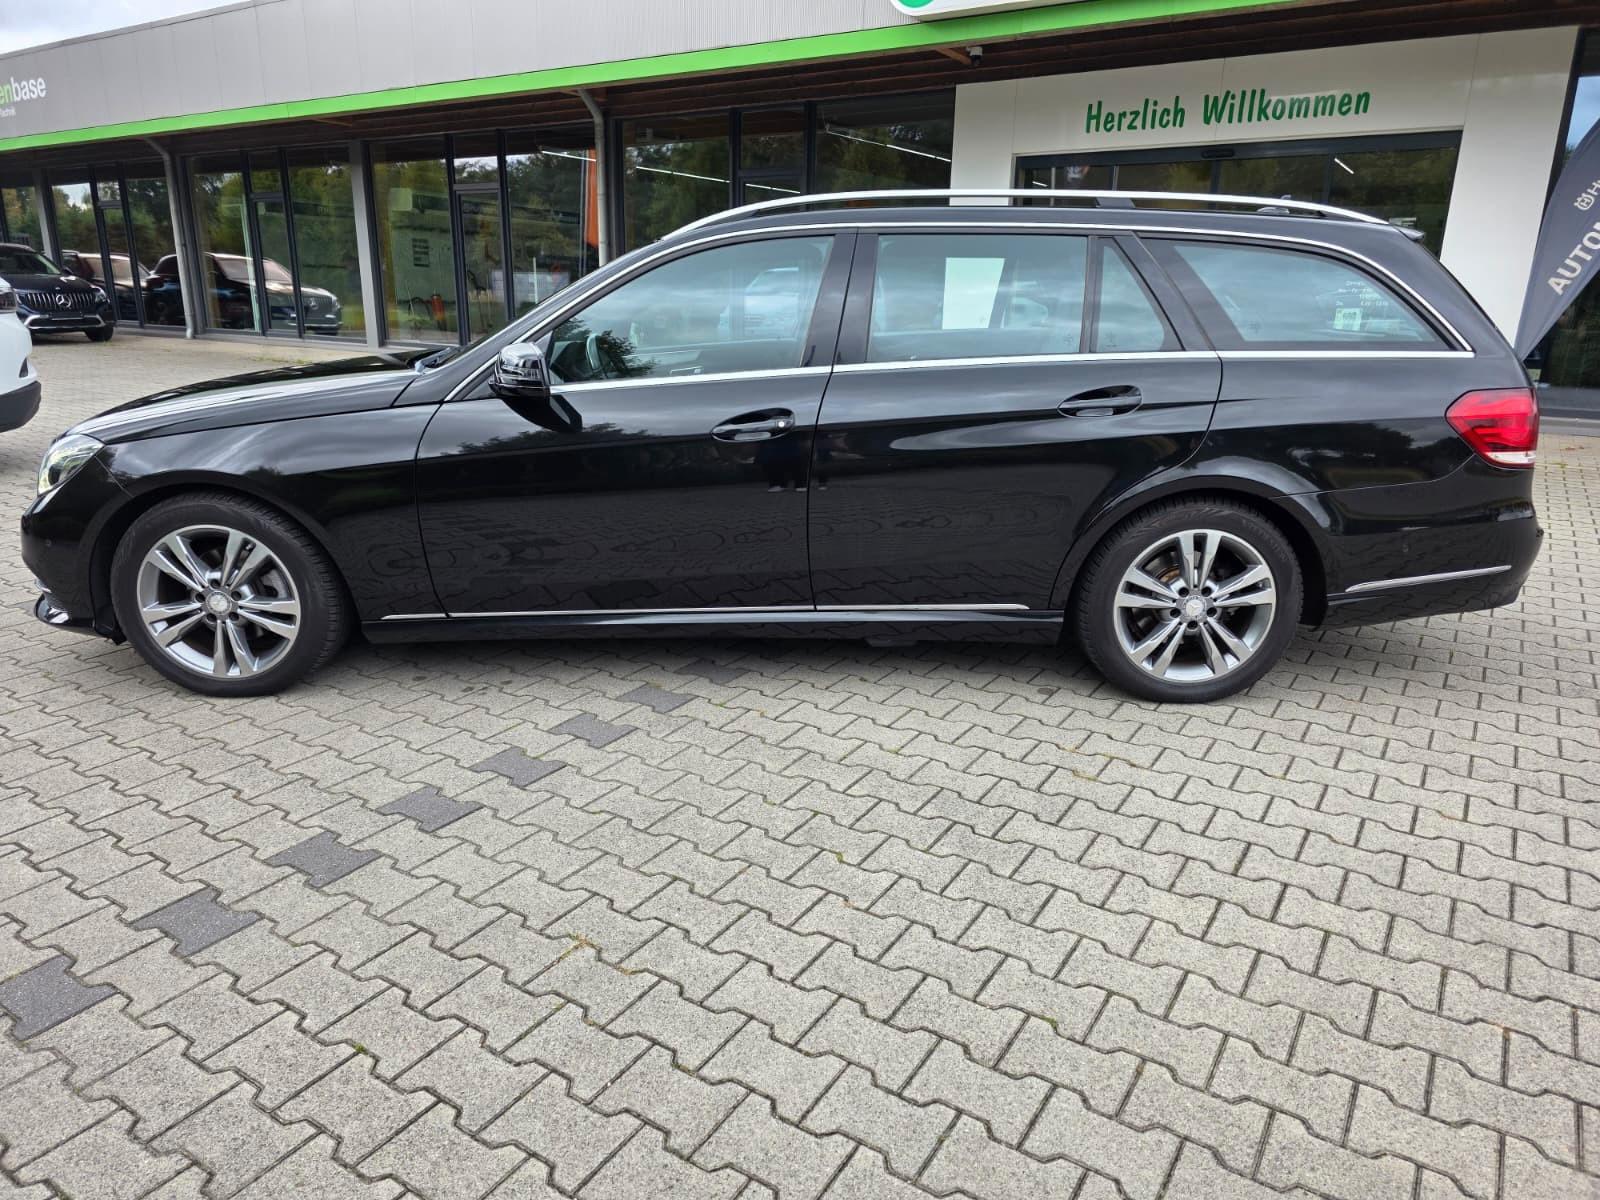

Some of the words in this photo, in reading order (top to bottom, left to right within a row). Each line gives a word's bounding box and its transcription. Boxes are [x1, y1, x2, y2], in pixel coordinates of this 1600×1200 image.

[1085, 95, 1186, 134] Herzlich
[1202, 88, 1371, 126] Willkommen
[1547, 222, 1600, 296] AUTO
